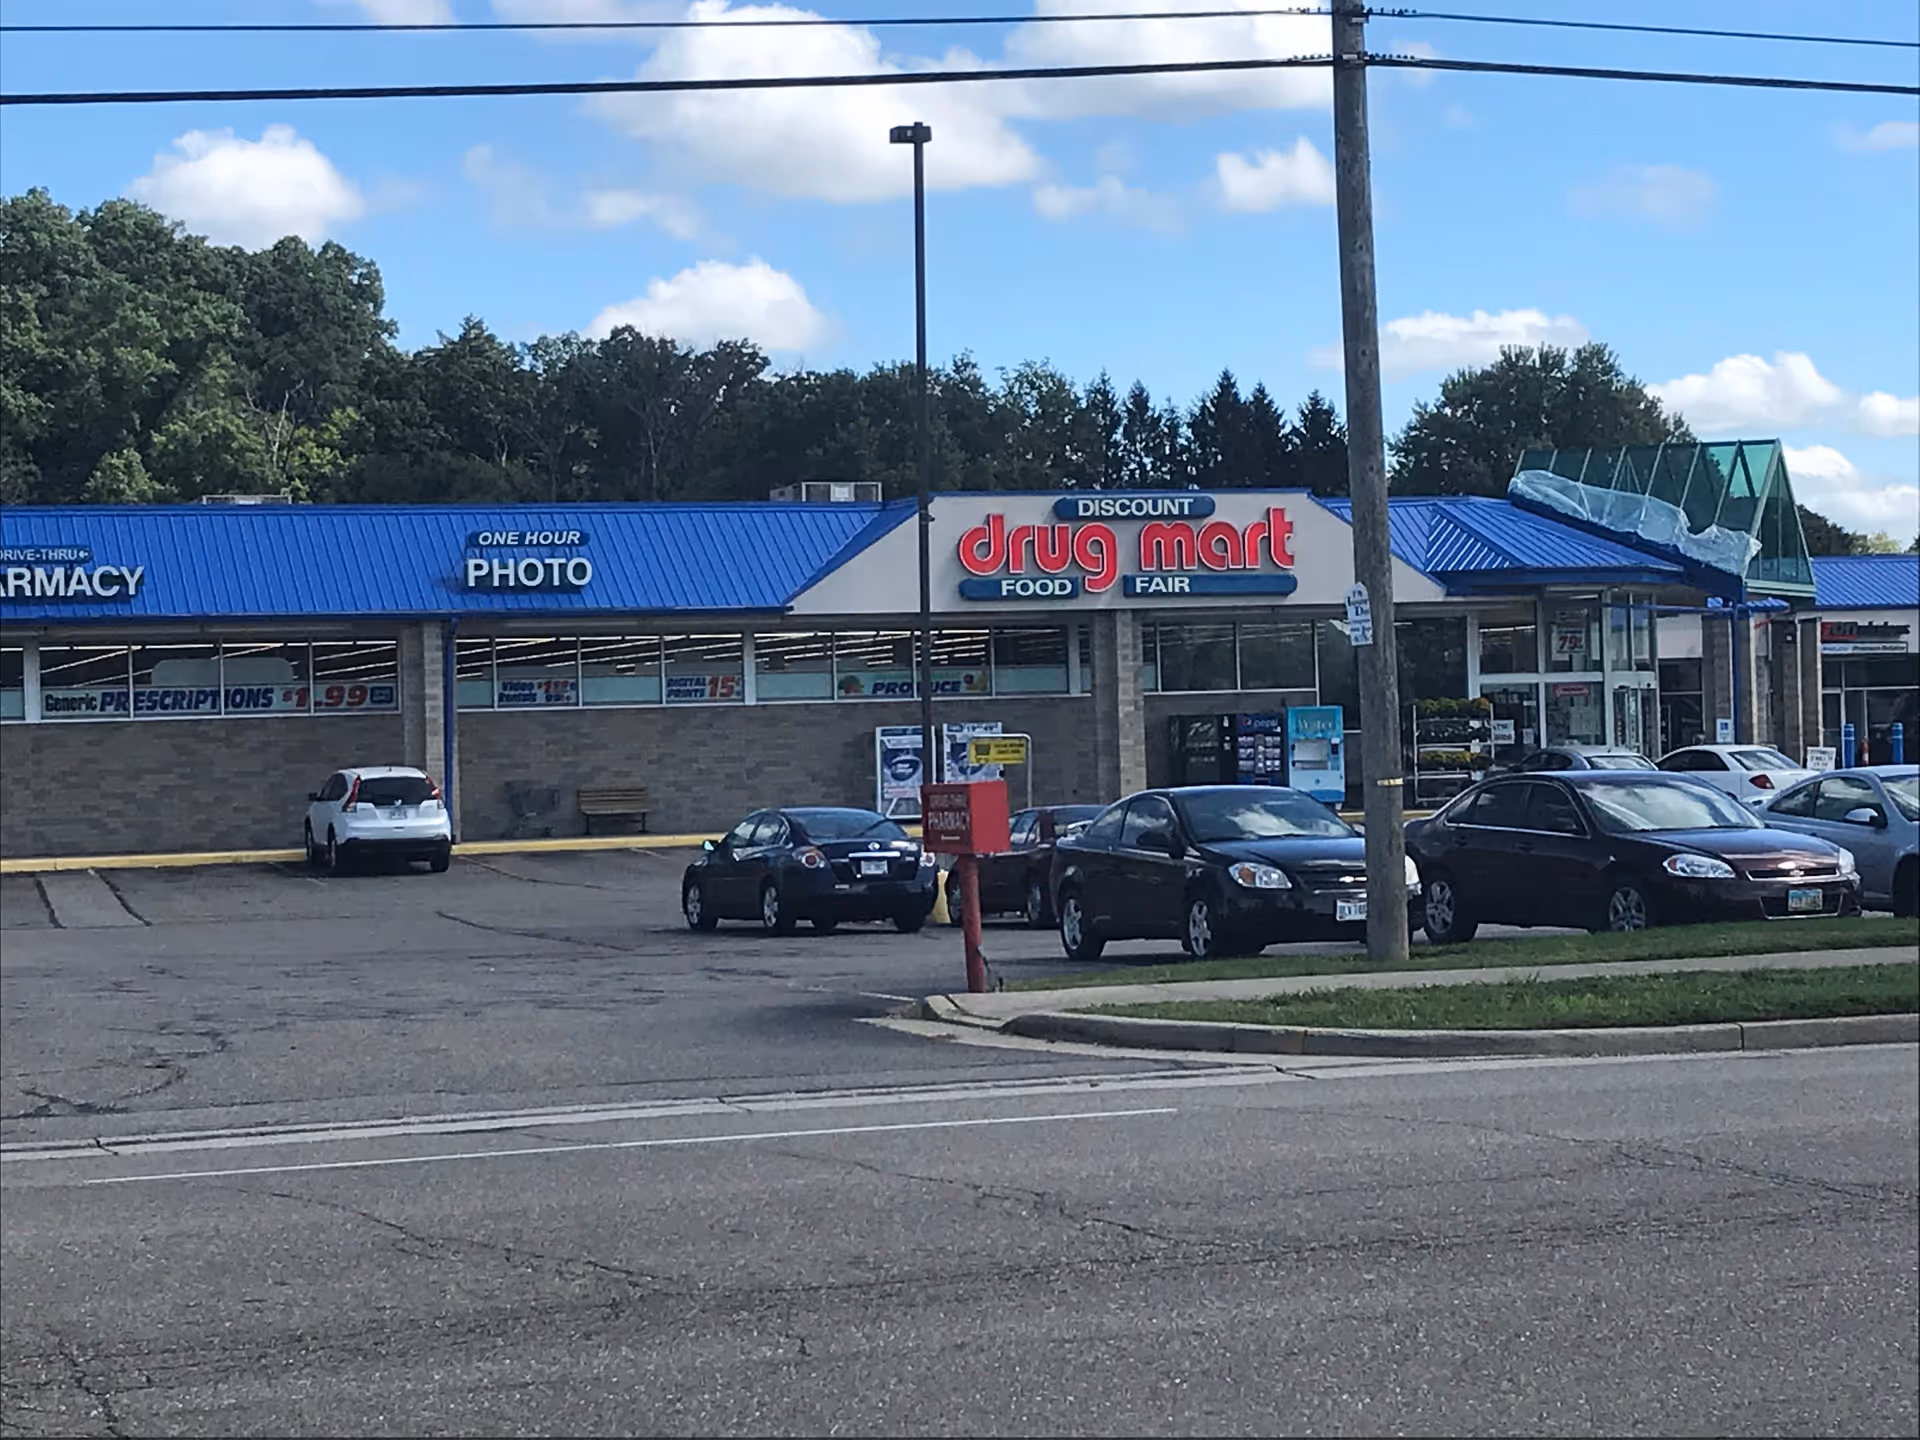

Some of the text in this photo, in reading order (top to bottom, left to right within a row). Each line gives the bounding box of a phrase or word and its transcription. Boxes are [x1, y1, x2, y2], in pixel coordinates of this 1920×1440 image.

[1077, 499, 1194, 517] DISCOUNT
[478, 530, 581, 545] ONE HOUR
[958, 507, 1295, 593] drug mart
[467, 557, 593, 587] PHOTO
[1001, 577, 1190, 596] FOOD FAIR
